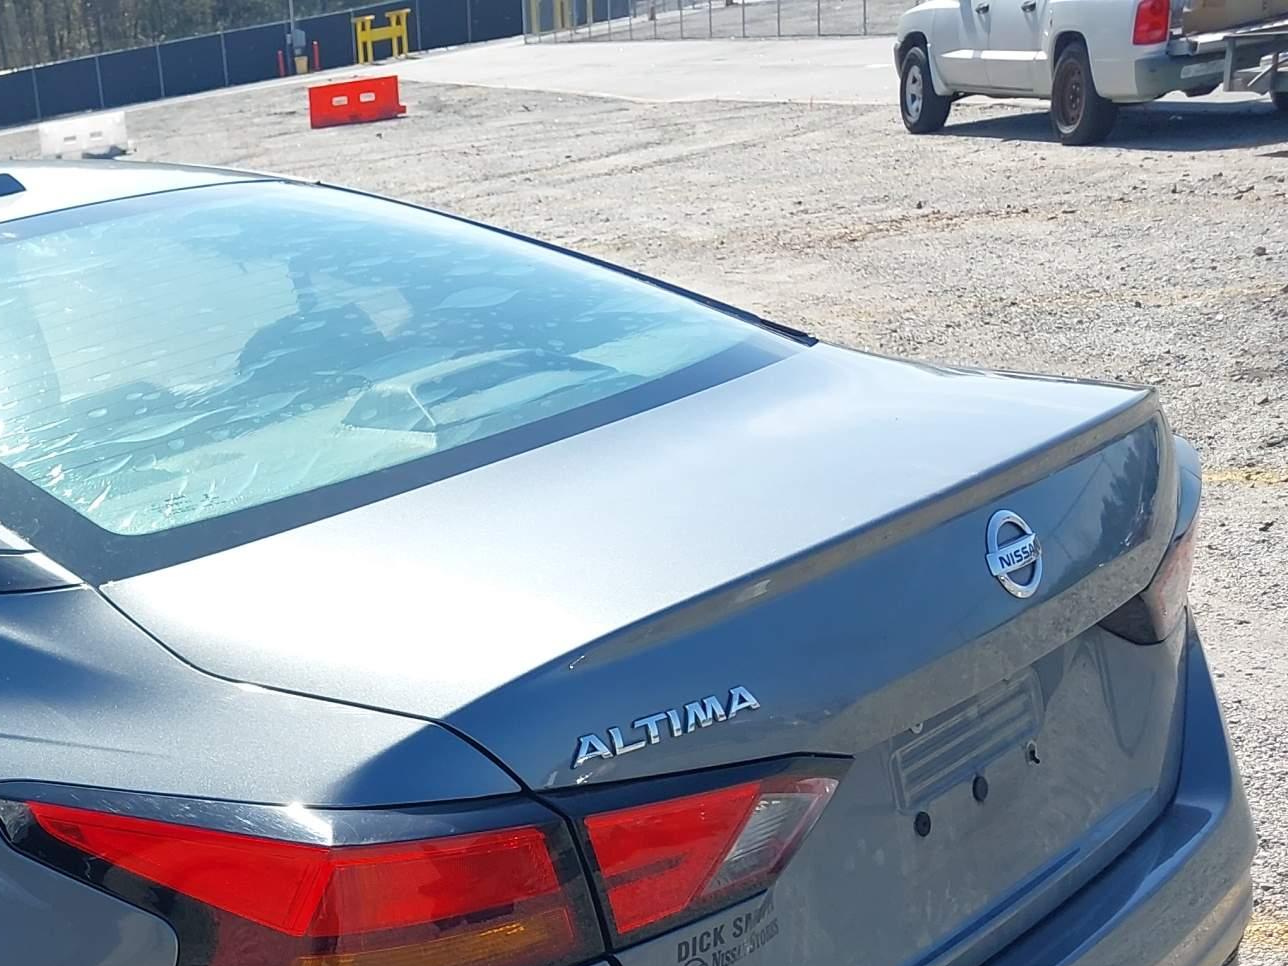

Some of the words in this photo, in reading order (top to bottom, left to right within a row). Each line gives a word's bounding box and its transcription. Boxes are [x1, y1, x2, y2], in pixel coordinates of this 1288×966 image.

[998, 541, 1040, 568] NISSA
[570, 684, 761, 769] ALTIMA
[677, 924, 725, 963] DICK
